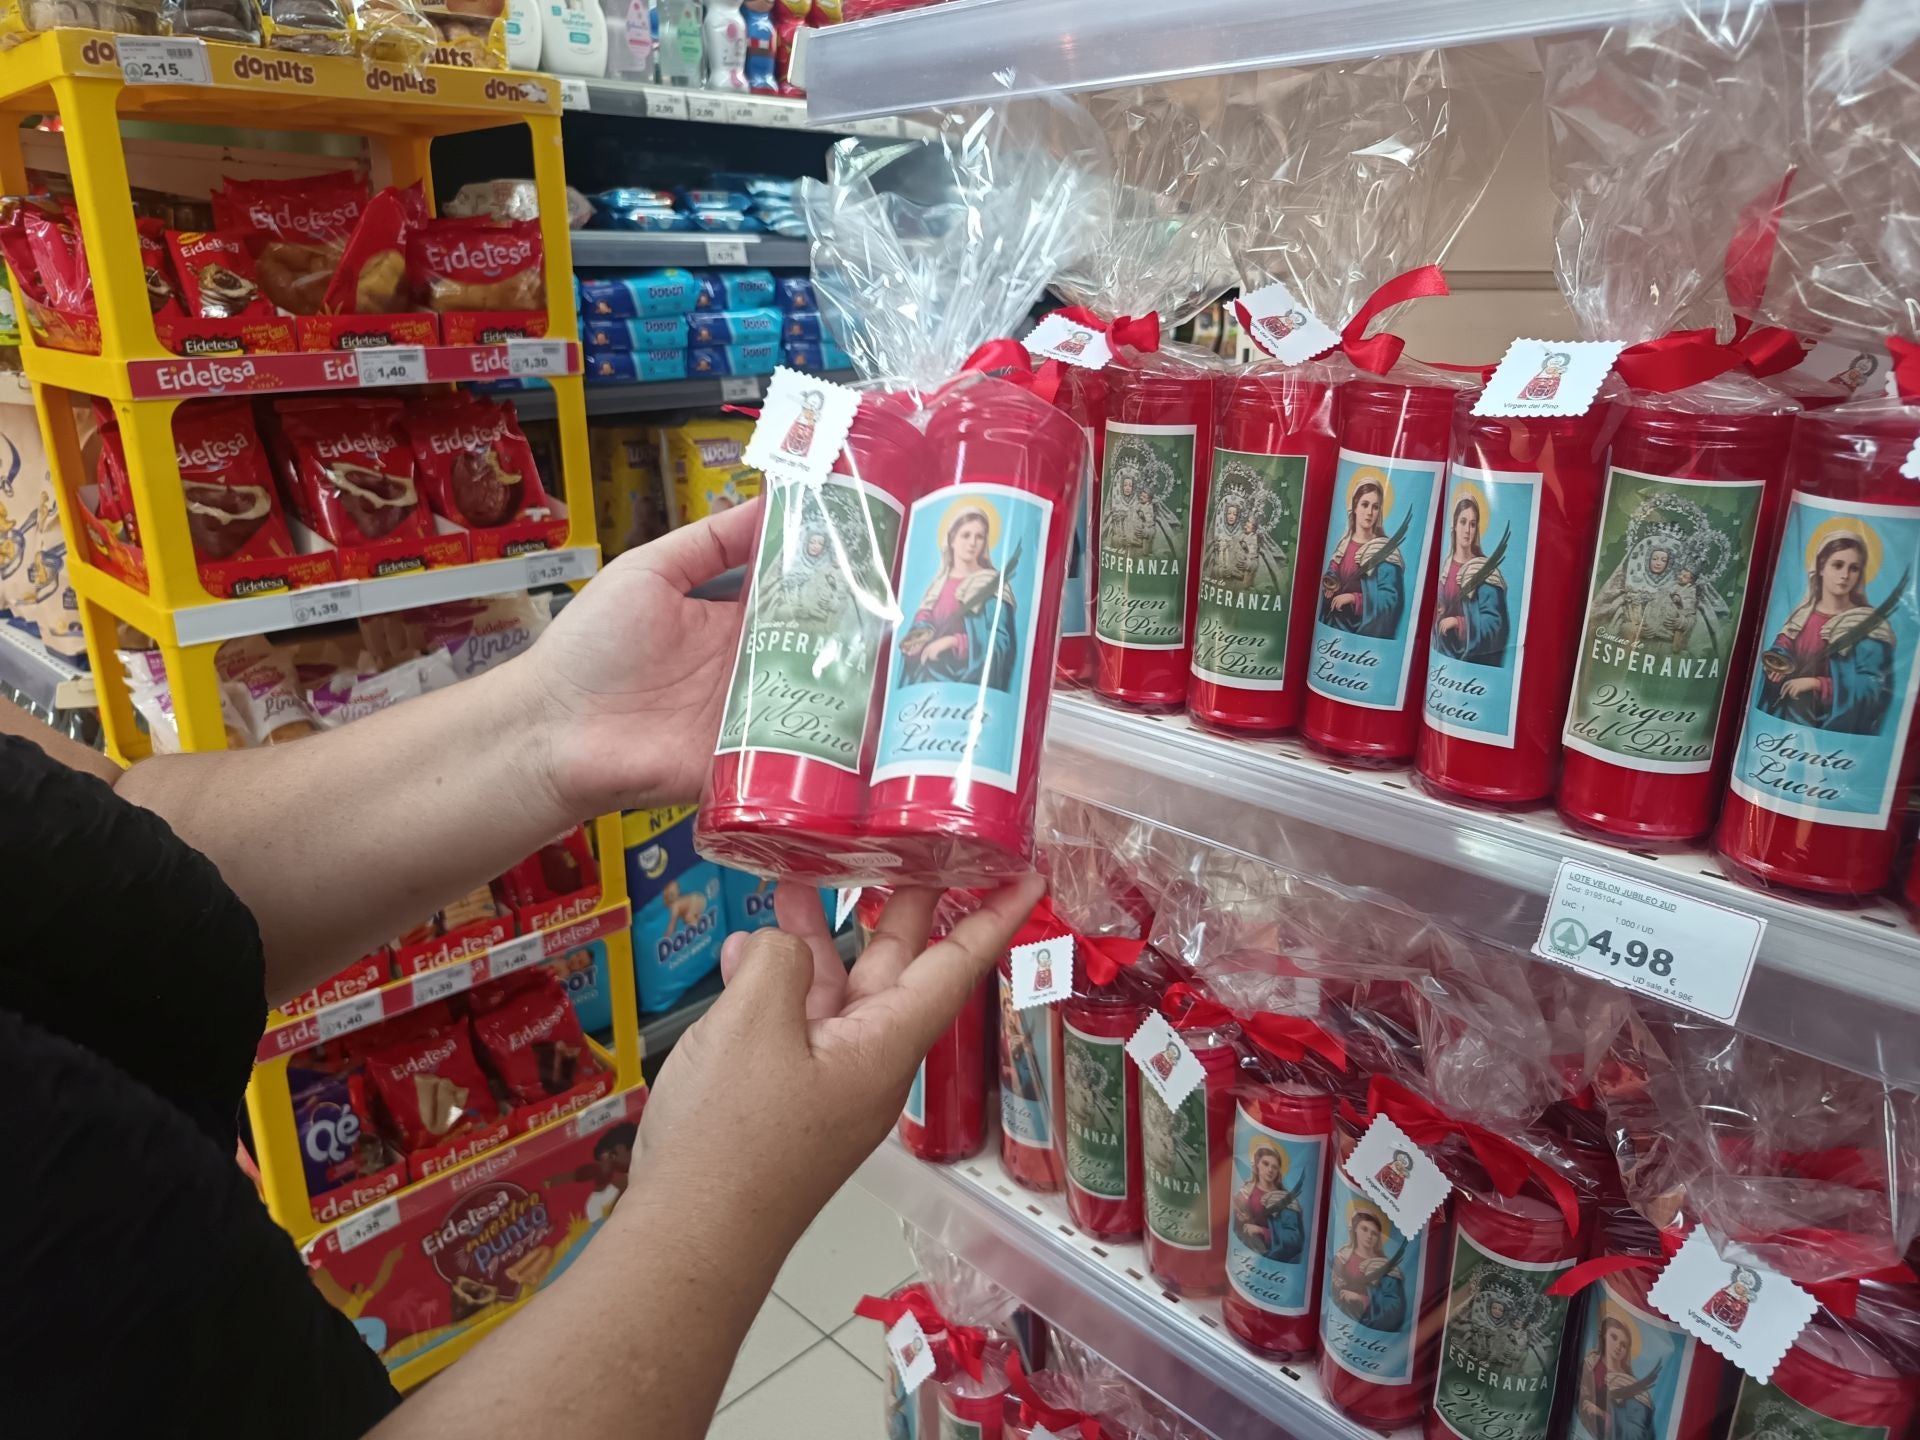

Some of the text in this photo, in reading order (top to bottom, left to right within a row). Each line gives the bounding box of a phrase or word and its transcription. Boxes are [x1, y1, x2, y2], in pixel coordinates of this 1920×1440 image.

[142, 63, 179, 78] 2,15
[233, 54, 315, 84] donuts
[366, 67, 437, 95] donuts
[484, 78, 545, 103] don
[249, 201, 360, 233] Eidetesa
[425, 240, 532, 273] Eidetesa
[185, 339, 239, 354] Eidetesa
[341, 335, 388, 349] Eidetesa
[156, 360, 256, 391] Eidetesa
[377, 366, 406, 379] 1,40
[471, 348, 510, 373] Eide
[1528, 402, 1540, 410] del
[177, 432, 249, 469] detesa
[316, 431, 397, 459] Eidetesa
[430, 419, 509, 454] Eidetesa
[506, 540, 545, 556] Eidetesa
[1101, 551, 1180, 576] ESPERANZA
[377, 557, 421, 575] Eidetesa
[234, 576, 284, 597] Eidetesa
[1103, 584, 1168, 622] Virgen
[1200, 582, 1283, 612] ESPERANZA
[1120, 615, 1181, 637] Pino
[1201, 616, 1267, 655] Virgen
[1595, 626, 1645, 649] Camino de
[1215, 651, 1280, 677] Pino
[1317, 637, 1380, 667] Santa
[1591, 638, 1720, 679] ESPERANZA
[1313, 657, 1370, 692] Lucía
[1429, 665, 1488, 697] Santa
[743, 670, 847, 722] Virgen
[898, 690, 992, 724] Santa
[1426, 689, 1479, 723] Lucía
[1591, 682, 1698, 736] Virgen
[773, 710, 855, 753] Pino
[1573, 715, 1708, 758] del Pino
[1753, 732, 1857, 770] Santa
[1749, 754, 1842, 801] Lucía
[1569, 872, 1678, 912] LOTE VELON JUBILEO 2UD
[545, 917, 600, 953] idetesa
[1641, 926, 1654, 935] UD
[413, 925, 505, 974] Eidetesa
[1587, 929, 1674, 976] 4,98
[280, 965, 380, 1017] Eidetesa
[1632, 975, 1645, 985] UD
[1646, 980, 1662, 991] sale
[276, 1021, 319, 1050] Eide
[509, 1003, 566, 1051] Eidetesa
[391, 1039, 457, 1080] Eidetesa
[527, 1081, 606, 1129] Eidetesa
[306, 1103, 361, 1163] Qé
[1070, 1119, 1118, 1146] ERANZA
[421, 1125, 509, 1179] Eidetesa
[451, 1147, 518, 1193] Eidetesa
[1150, 1165, 1201, 1194] ERANZA
[314, 1172, 399, 1221] idetesa
[422, 1191, 510, 1256] Eidetesa
[474, 1205, 548, 1273] punto
[1234, 1248, 1288, 1285] Santa
[1236, 1269, 1282, 1301] Lucía
[1329, 1313, 1388, 1353] Santa
[1687, 1308, 1743, 1350] Virgen del Pino
[1331, 1334, 1382, 1371] Lucía
[1448, 1344, 1548, 1393] ESPERANZA
[1451, 1382, 1533, 1425] Virgen
